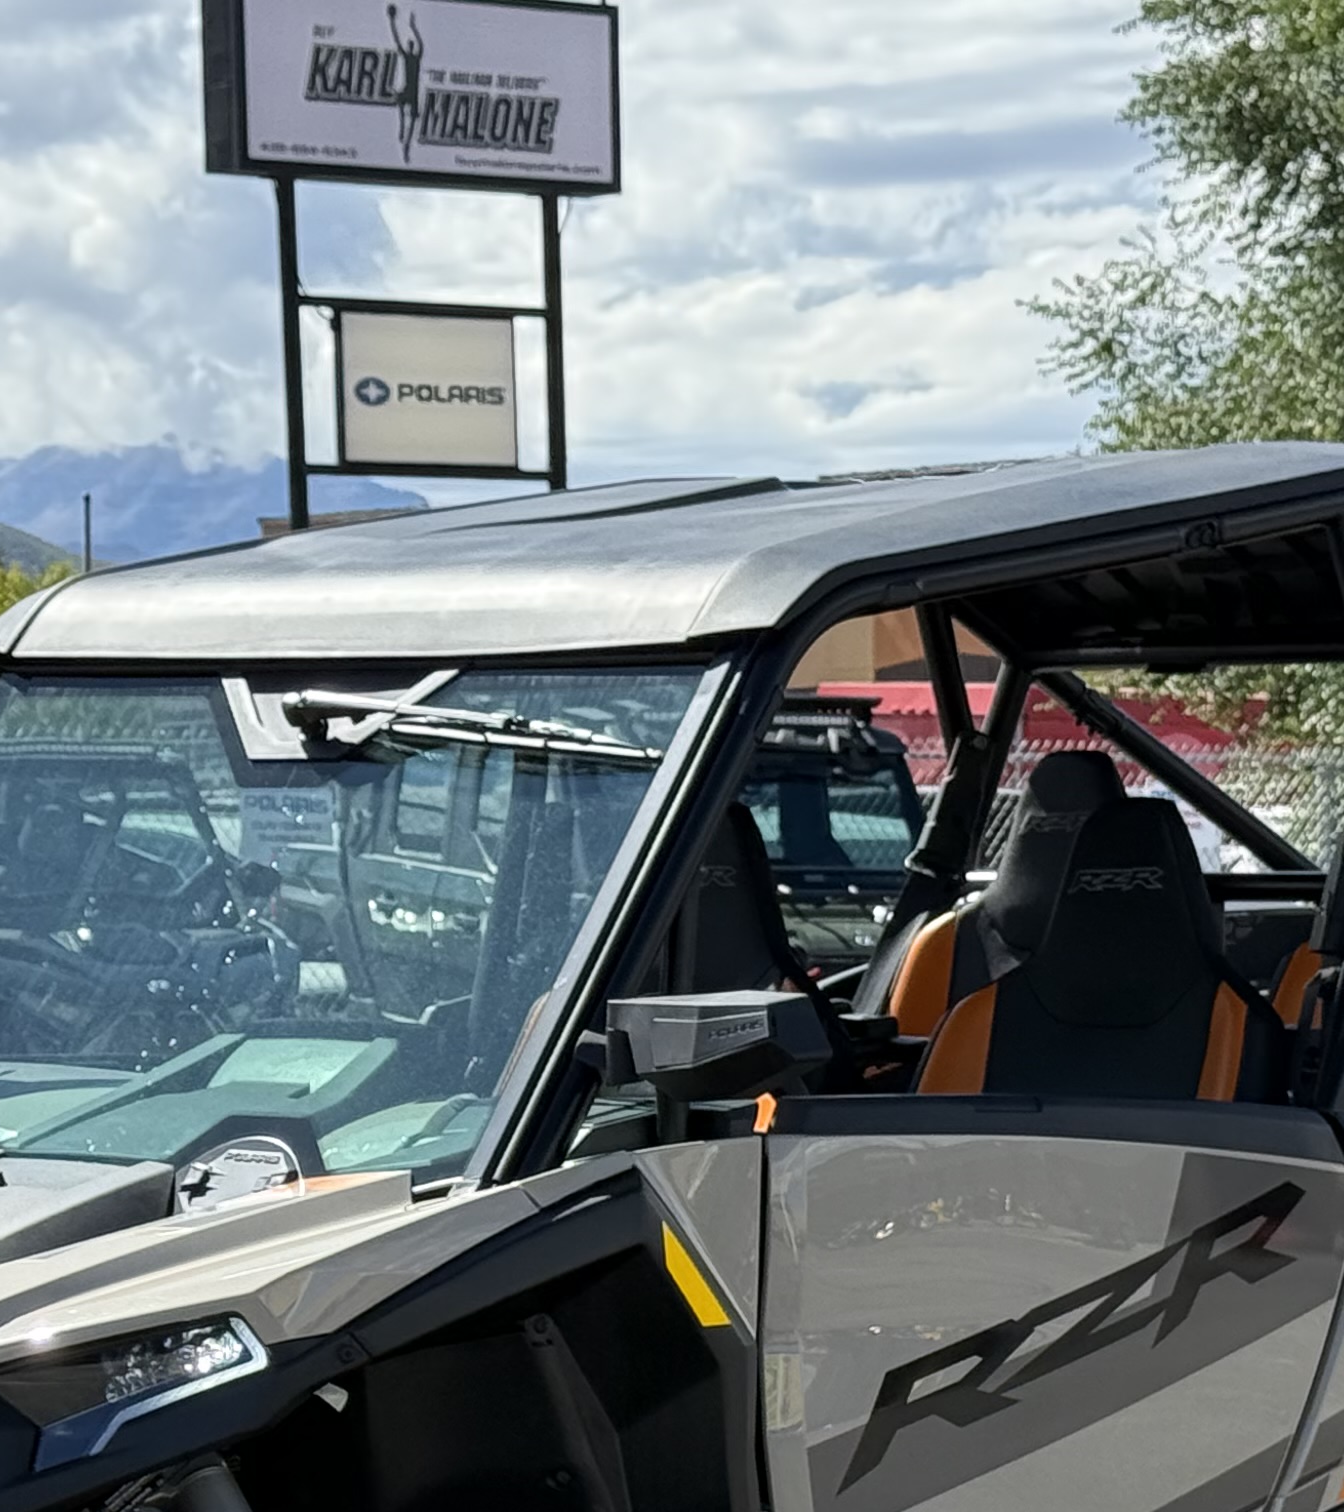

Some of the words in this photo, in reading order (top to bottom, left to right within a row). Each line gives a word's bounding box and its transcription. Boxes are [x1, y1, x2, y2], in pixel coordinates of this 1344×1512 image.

[307, 45, 399, 100] KARL
[420, 90, 558, 149] MALONE
[398, 384, 506, 405] POLARIS
[1067, 867, 1164, 894] RZR
[835, 1181, 1306, 1496] RZR
